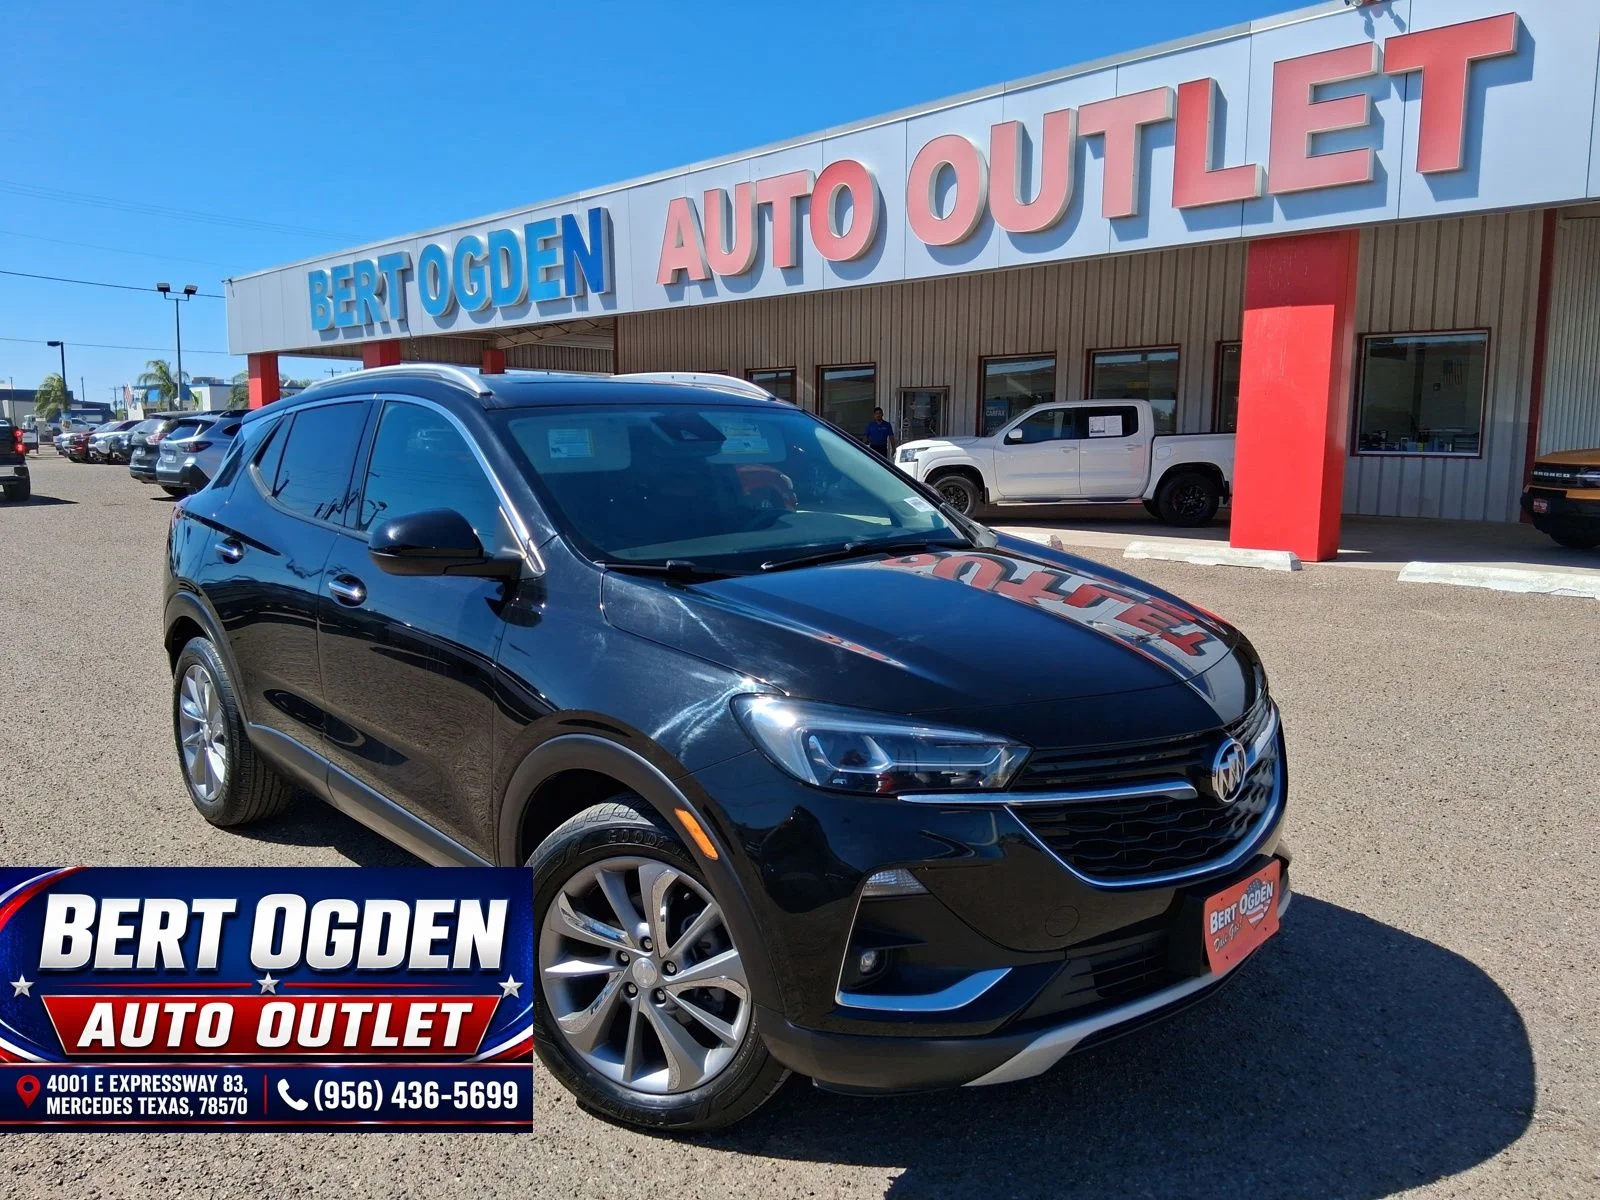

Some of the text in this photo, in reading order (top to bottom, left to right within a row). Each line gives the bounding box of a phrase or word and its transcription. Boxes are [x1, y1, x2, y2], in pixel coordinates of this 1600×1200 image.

[308, 11, 1518, 331] BERT OGDEN AUTO OUTLET
[1533, 470, 1570, 478] BRONCO
[1210, 881, 1274, 935] BERT OGDEN
